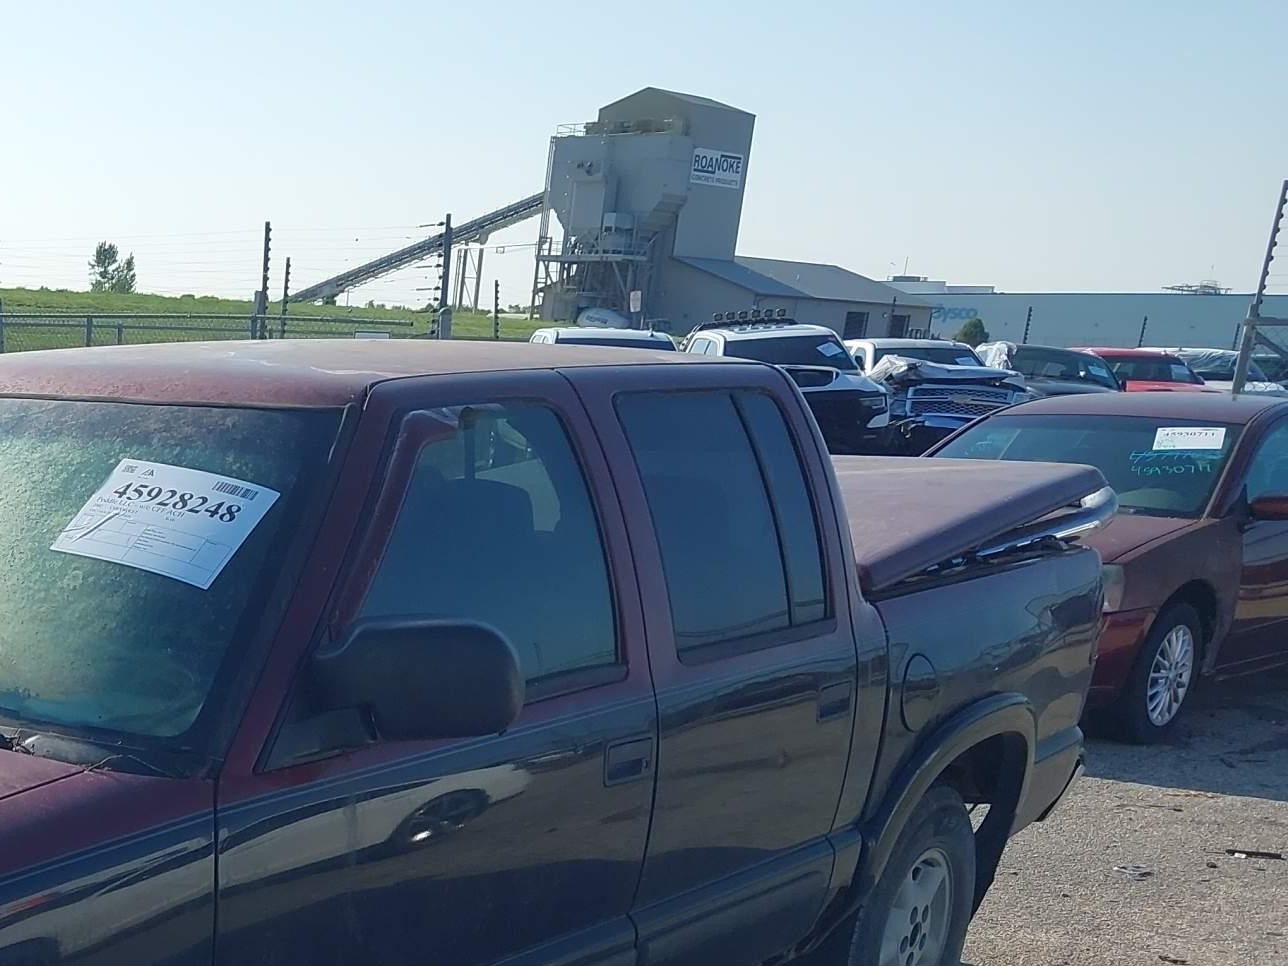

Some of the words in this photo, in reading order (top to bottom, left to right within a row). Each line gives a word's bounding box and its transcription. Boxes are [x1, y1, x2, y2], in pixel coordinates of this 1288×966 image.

[693, 155, 742, 174] ROANOKE
[692, 174, 714, 183] CONCRETE
[113, 481, 242, 523] 45928248
